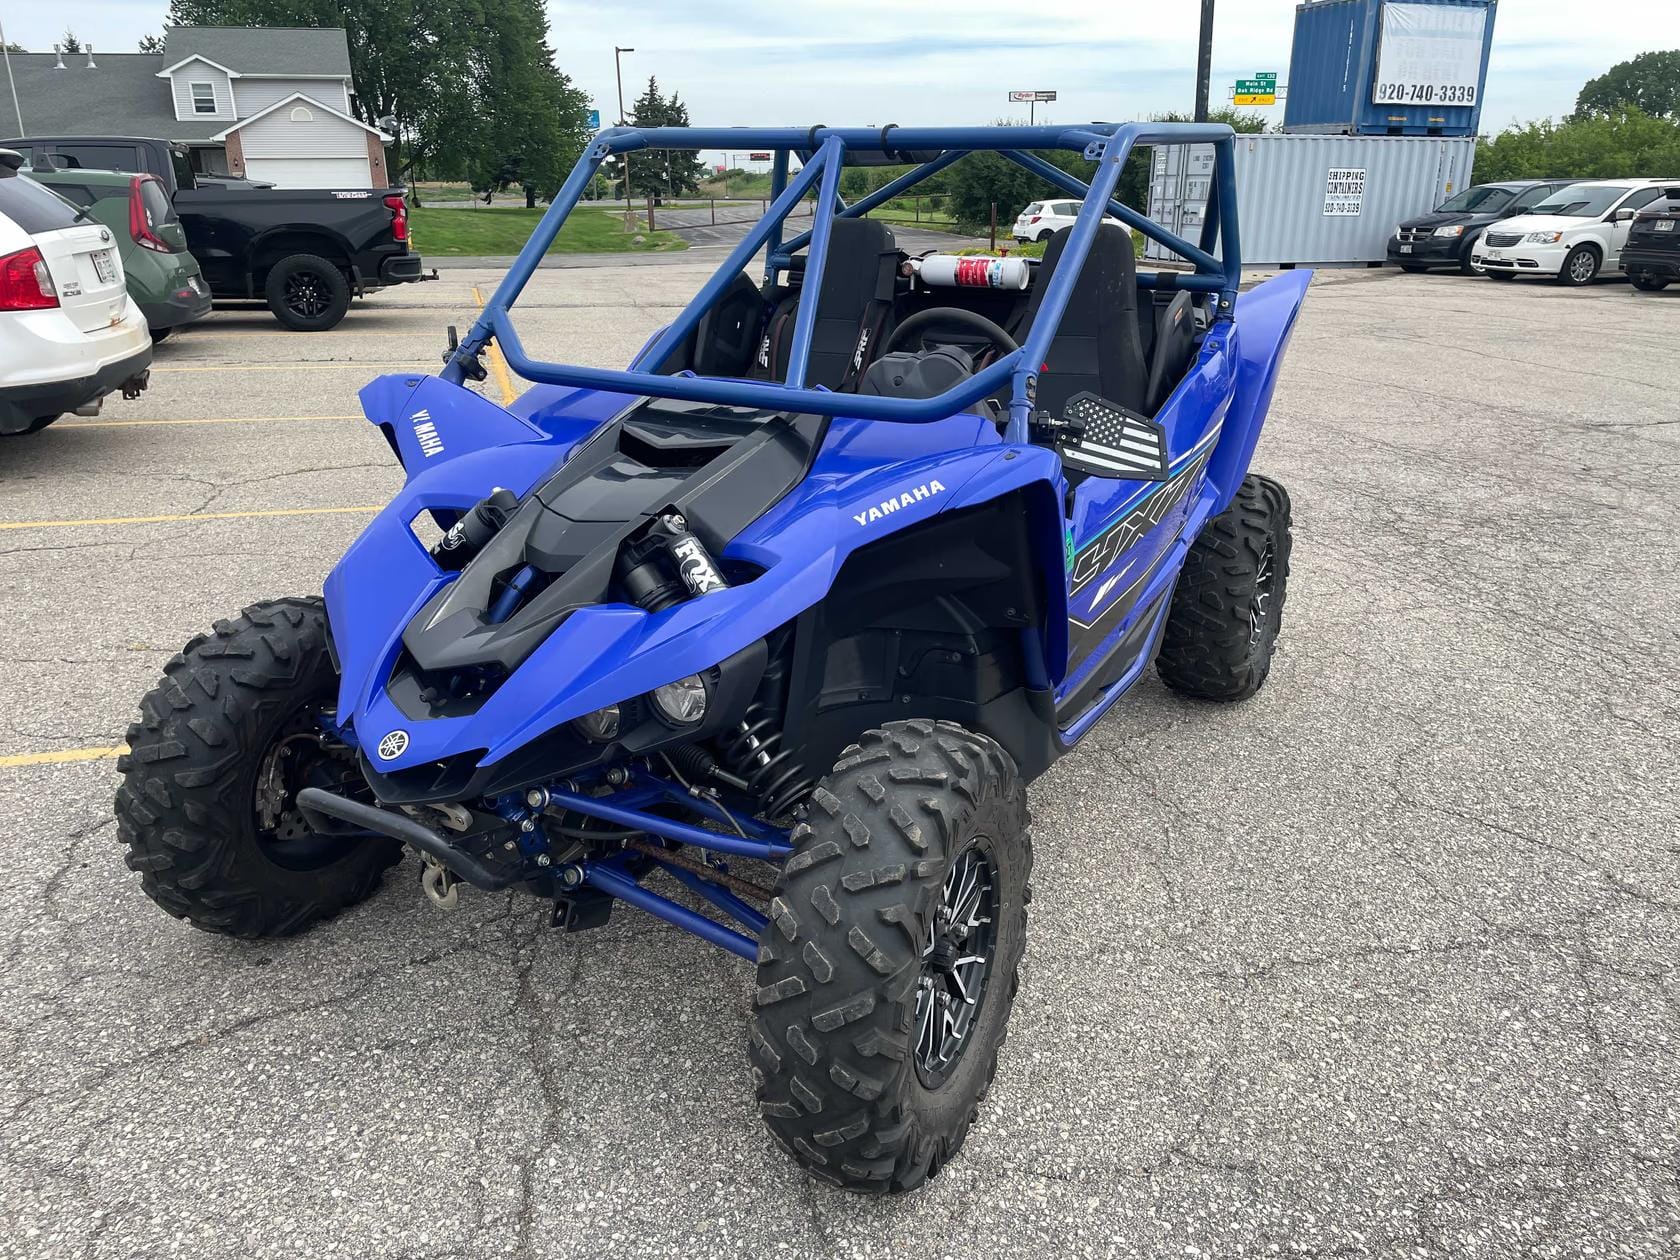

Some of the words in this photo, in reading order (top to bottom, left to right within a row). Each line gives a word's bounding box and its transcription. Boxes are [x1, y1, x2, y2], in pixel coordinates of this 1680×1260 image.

[1379, 83, 1475, 103] 920-740-3339
[1328, 171, 1365, 181] SHIPPING
[1327, 182, 1363, 194] CONTAINERS
[852, 479, 946, 527] YAMAHA
[674, 540, 721, 594] FOX
